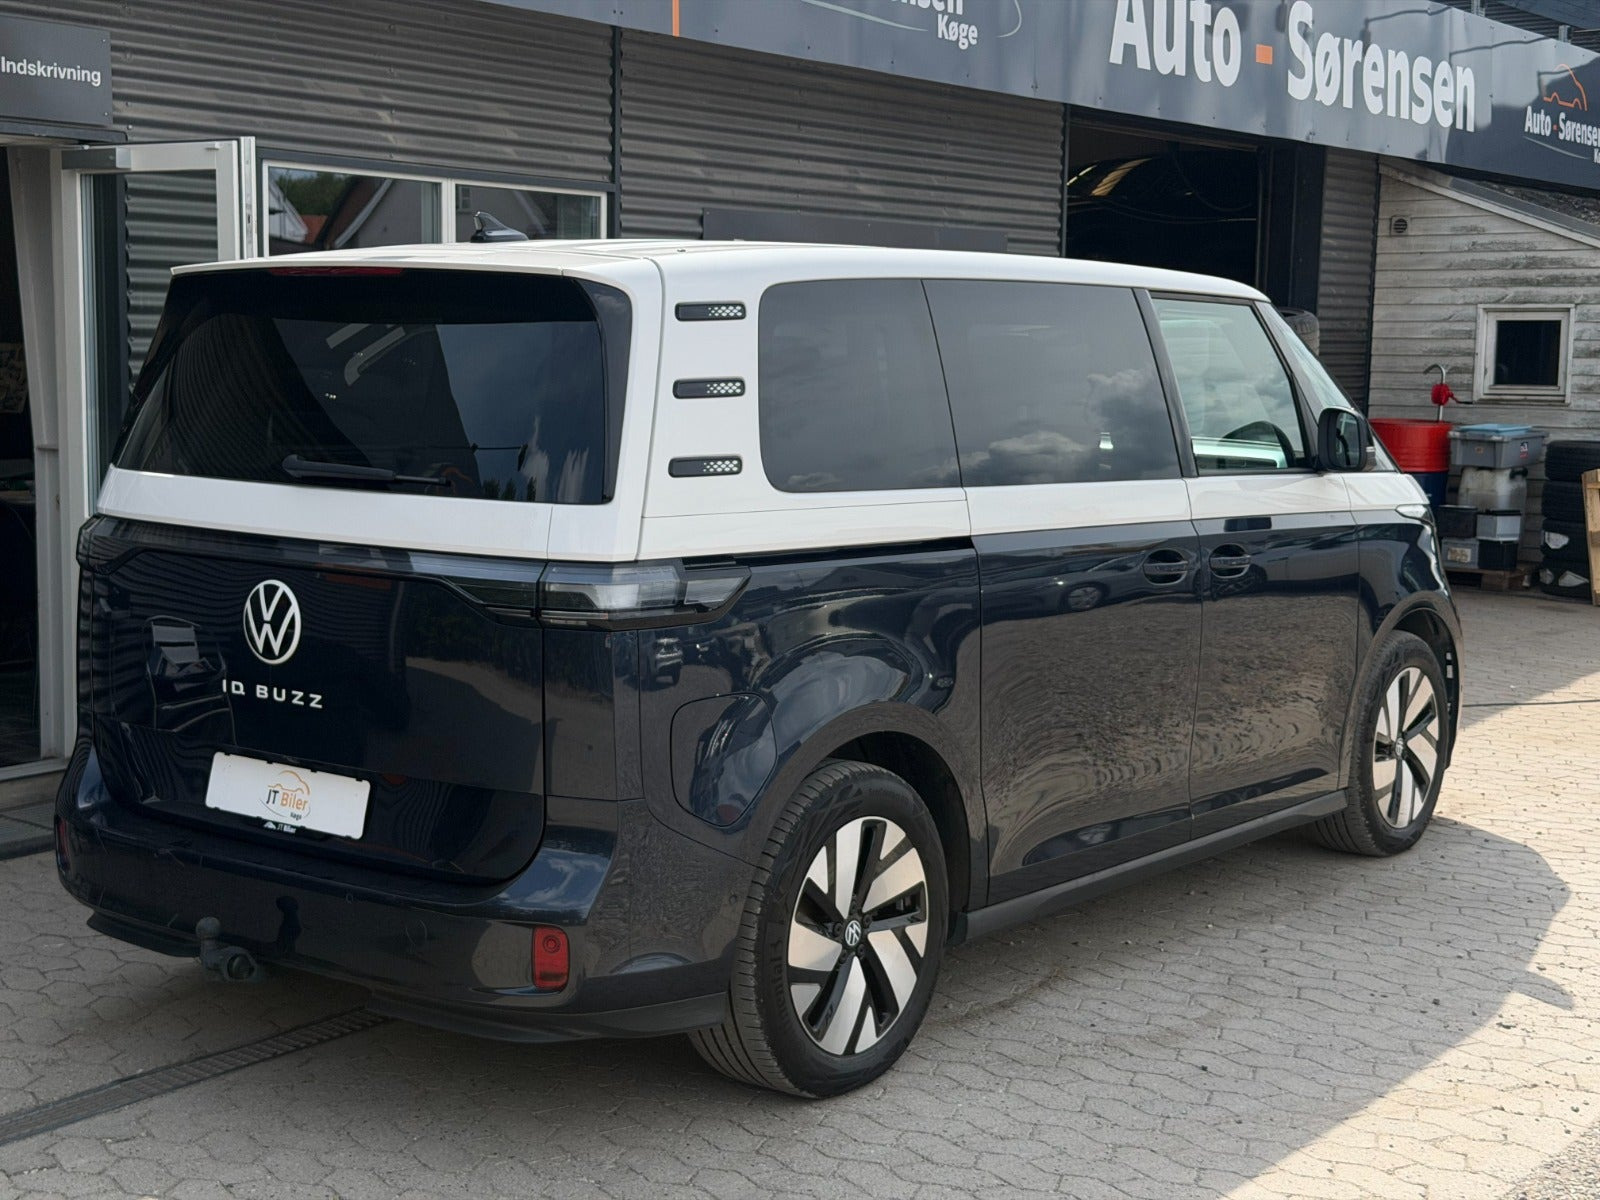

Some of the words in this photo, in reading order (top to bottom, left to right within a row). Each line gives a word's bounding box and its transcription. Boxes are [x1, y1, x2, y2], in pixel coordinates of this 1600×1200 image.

[937, 13, 978, 50] Køge
[1, 56, 101, 87] Indskrivning
[1109, 0, 1242, 87] Auto
[1287, 0, 1475, 133] Sørensen
[1524, 105, 1552, 136] Auto
[256, 685, 323, 709] BUZZ
[266, 789, 279, 804] JT
[281, 792, 308, 811] Biler
